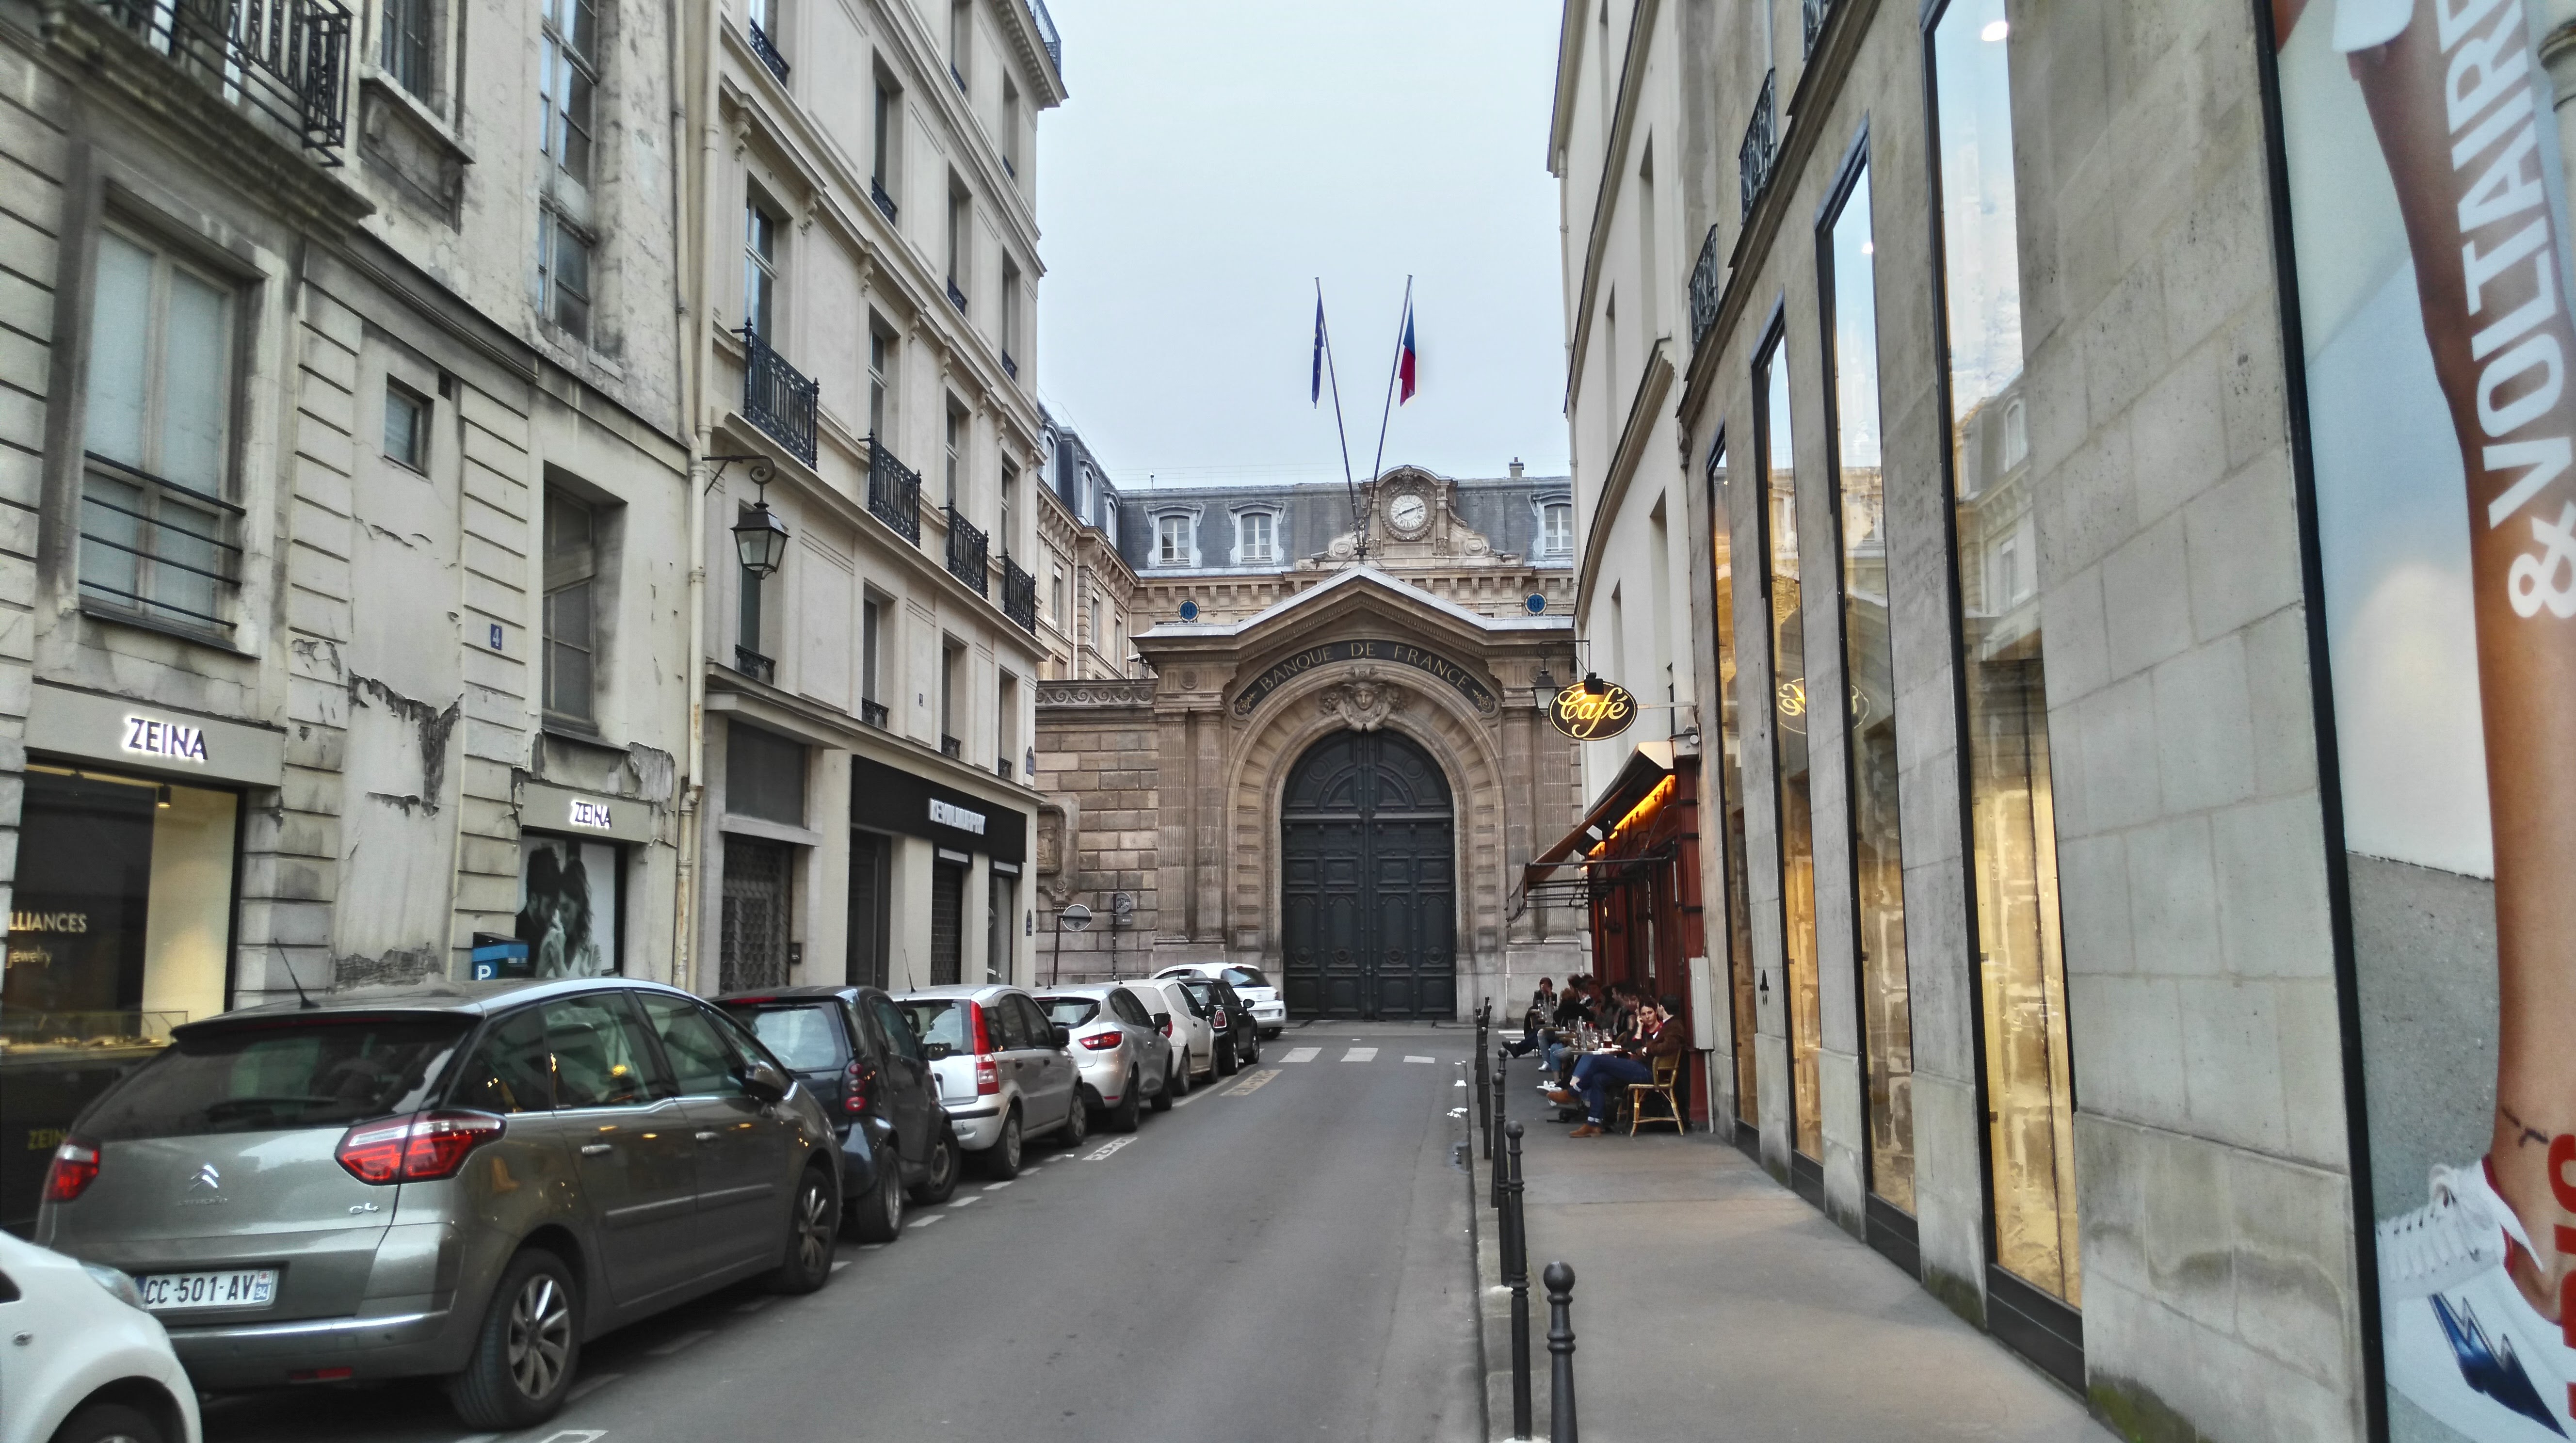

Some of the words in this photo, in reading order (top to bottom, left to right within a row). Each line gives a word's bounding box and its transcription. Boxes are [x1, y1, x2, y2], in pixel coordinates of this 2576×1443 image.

[492, 628, 500, 647] 4
[1259, 646, 1334, 691] BANQUE
[1351, 642, 1376, 657] DE
[1394, 644, 1471, 691] FRANCE
[1557, 687, 1629, 738] Café
[128, 717, 209, 760] ZEINA
[574, 801, 612, 828] ZEINA
[478, 965, 492, 980] P
[349, 1202, 381, 1215] C4
[146, 1274, 255, 1304] CC-501-AV
[255, 1286, 267, 1298] 94
